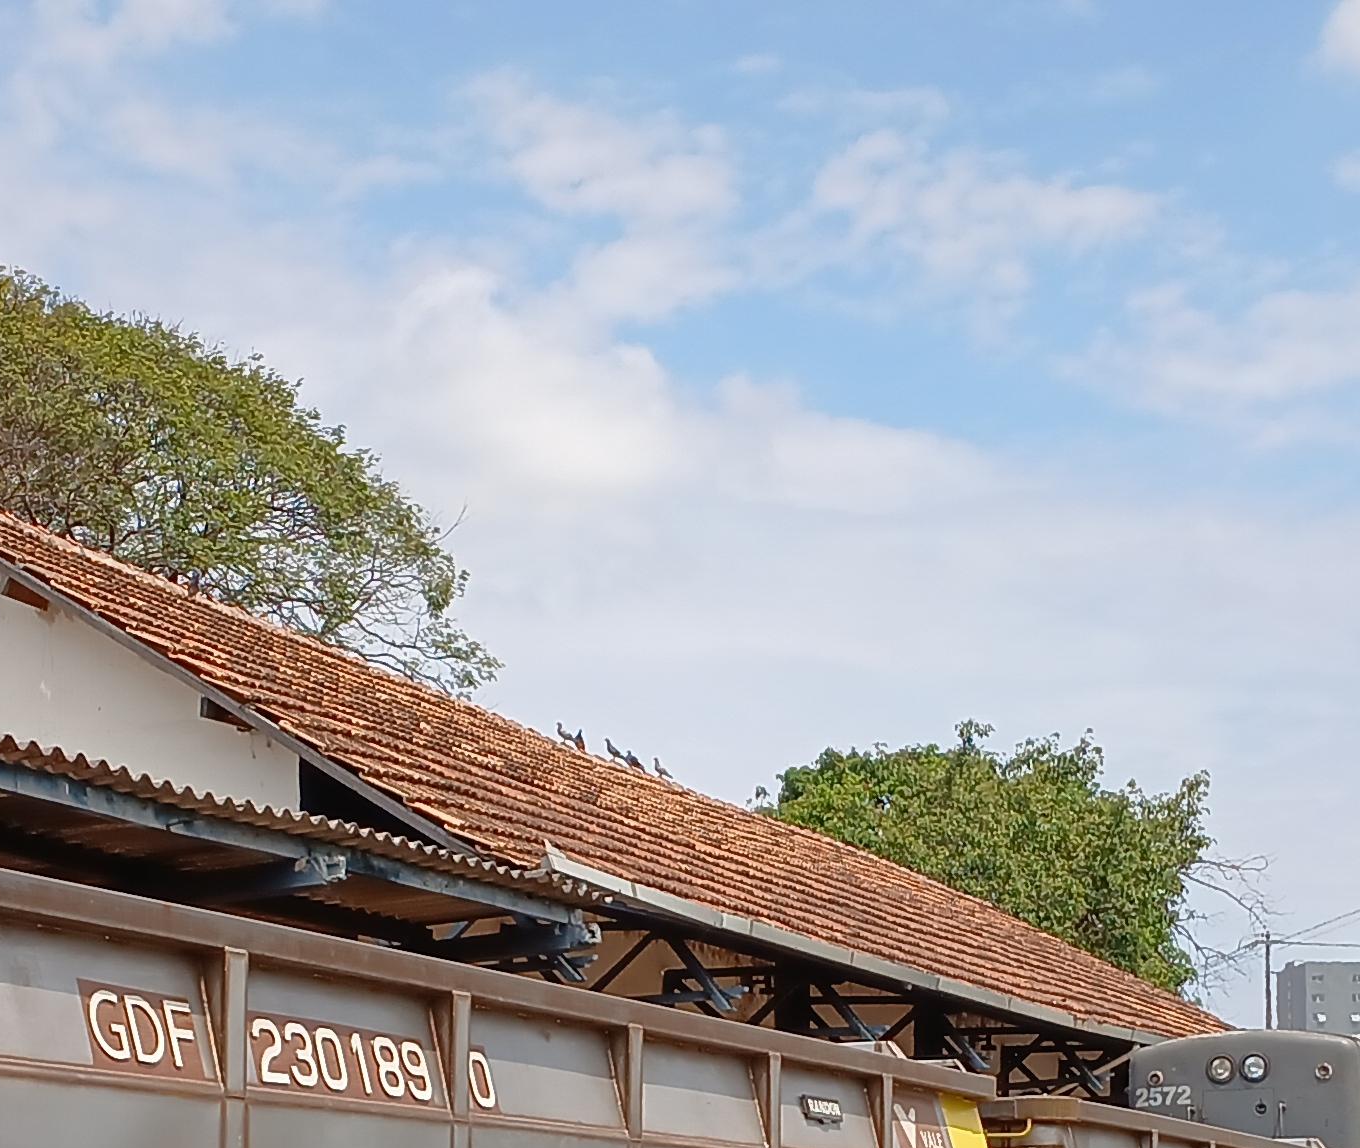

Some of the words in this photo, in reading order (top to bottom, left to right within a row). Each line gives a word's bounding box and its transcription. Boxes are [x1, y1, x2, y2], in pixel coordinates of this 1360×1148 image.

[88, 989, 196, 1069] GDF
[251, 1017, 433, 1102] 230189
[1135, 1085, 1192, 1109] 2572
